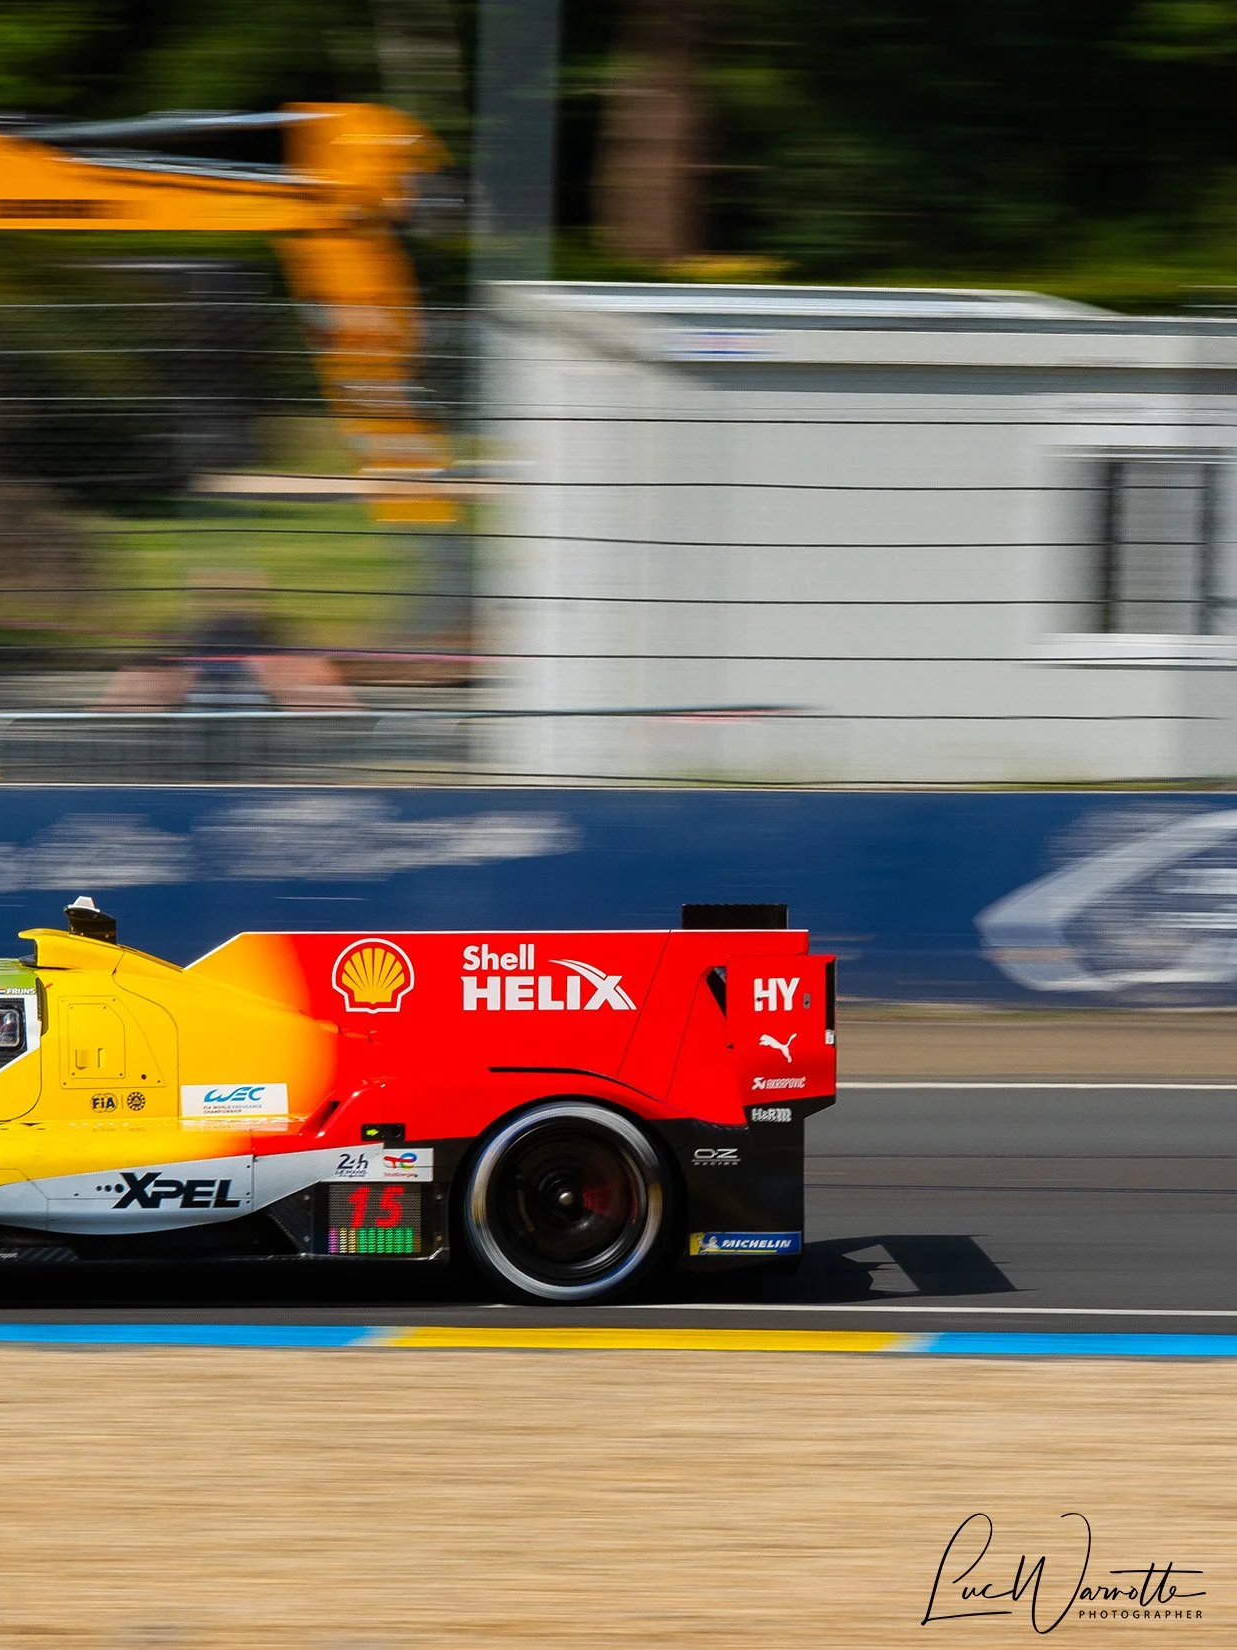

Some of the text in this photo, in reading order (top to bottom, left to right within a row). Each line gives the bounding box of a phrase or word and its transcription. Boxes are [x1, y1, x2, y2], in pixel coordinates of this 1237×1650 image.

[463, 944, 534, 970] Shell
[461, 959, 637, 1011] HELIX
[754, 977, 800, 1011] HY
[203, 1086, 266, 1103] WEC
[337, 1153, 369, 1170] 24h
[112, 1171, 241, 1209] XPEL
[348, 1186, 406, 1228] 15
[721, 1239, 792, 1249] MICHELIN
